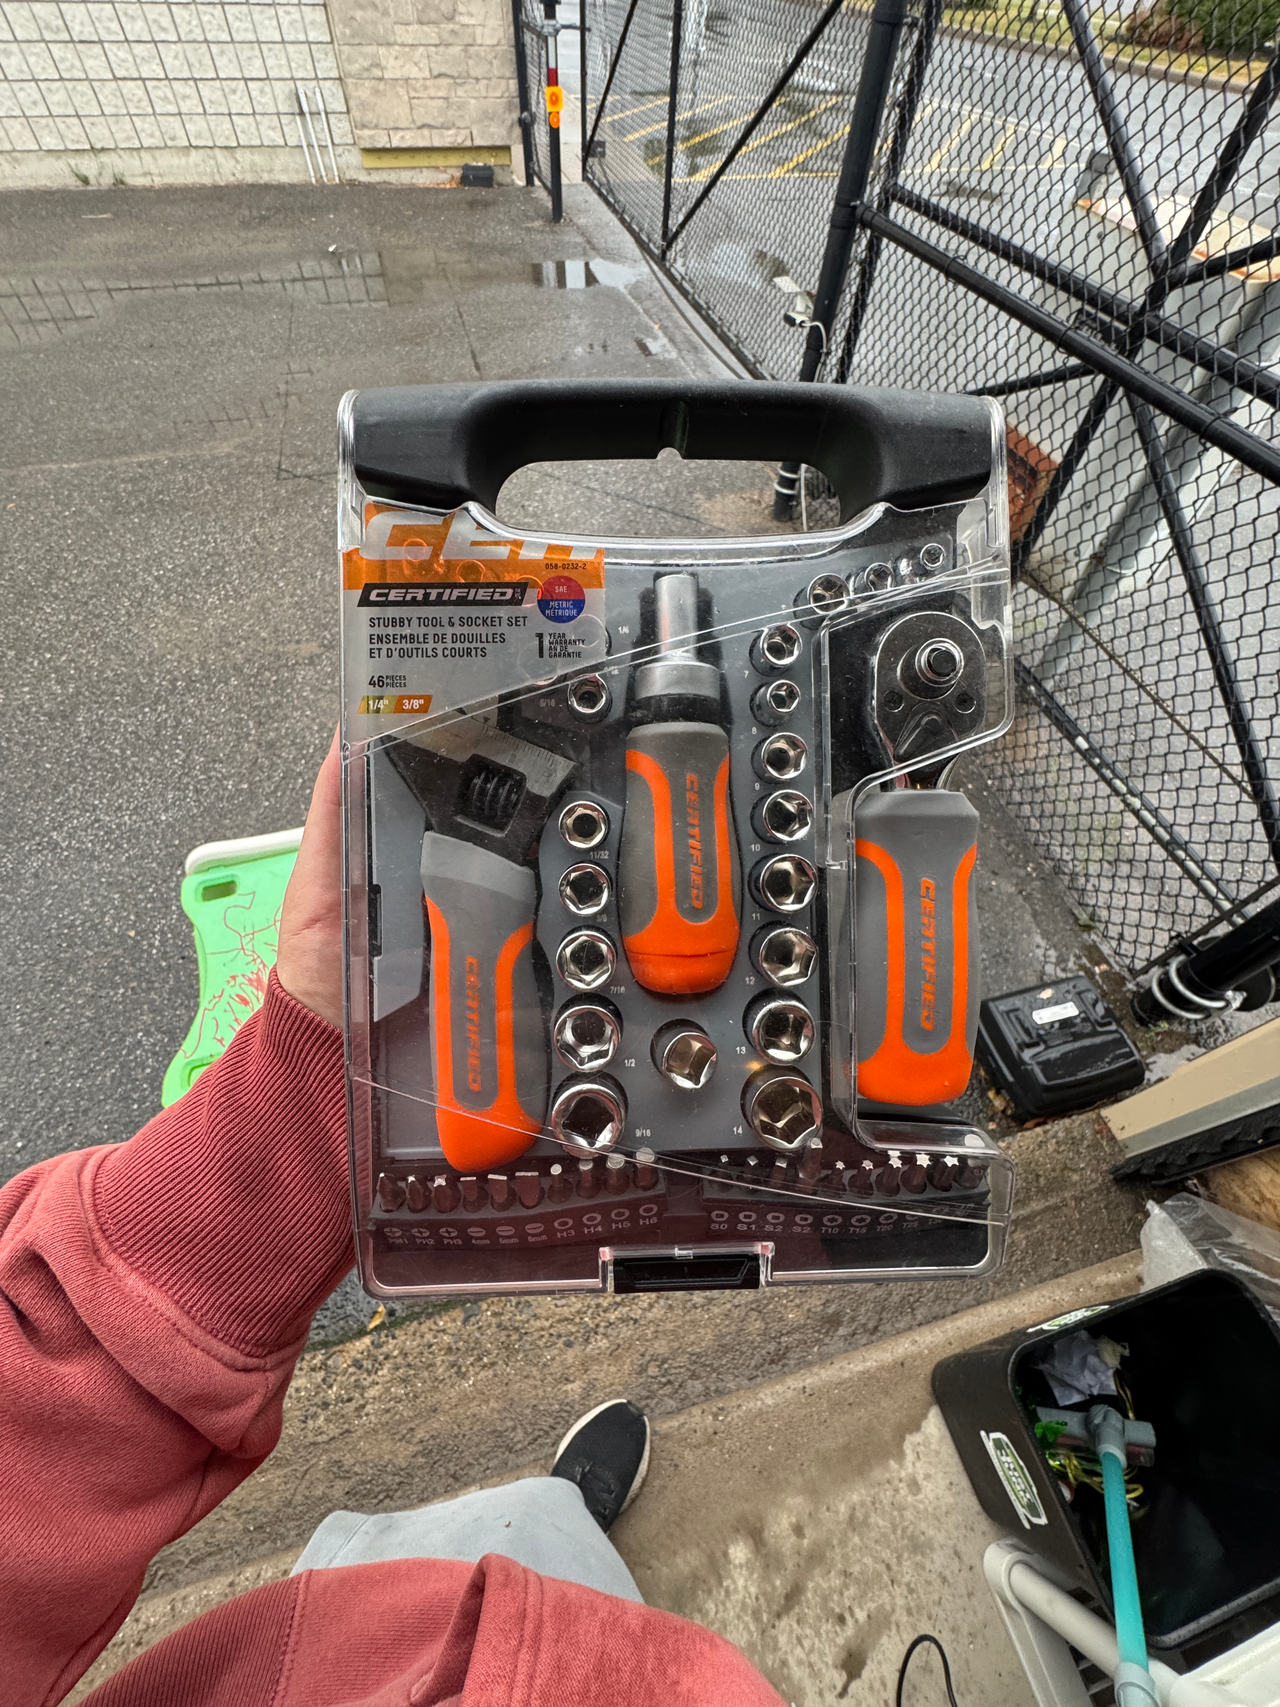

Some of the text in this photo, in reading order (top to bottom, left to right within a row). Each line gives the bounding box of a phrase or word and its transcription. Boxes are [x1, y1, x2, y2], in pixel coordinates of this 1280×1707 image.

[554, 585, 568, 593] SAE
[369, 588, 514, 601] CERTIFIED
[549, 600, 574, 609] METRIC
[369, 616, 528, 628] STUBBY TOOL & SOCKET SET
[369, 632, 506, 645] ENSEMBLE DE DOUILLES
[535, 633, 544, 659] 1
[369, 647, 488, 659] ET D'OUTILS COURTS
[548, 651, 582, 659] GARANTIE
[744, 670, 750, 679] 7
[368, 675, 385, 688] 46
[368, 699, 389, 710] 1/4"
[402, 699, 425, 710] 3/8"
[751, 727, 757, 735] 8
[754, 782, 760, 791] 9
[686, 773, 703, 909] CERTIFIED
[750, 843, 761, 852] 10
[590, 851, 609, 860] 11/32
[752, 912, 761, 921] 11
[920, 877, 936, 1031] CERTIFIED
[745, 976, 756, 985] 12
[610, 986, 626, 995] 7/16
[465, 955, 482, 1092] CERTIFIED
[735, 1045, 746, 1055] 13
[624, 1058, 636, 1068] 1/2
[635, 1128, 651, 1138] 9/16
[732, 1124, 743, 1136] 14
[556, 1228, 576, 1239] H3
[583, 1225, 603, 1235] H4
[736, 1222, 757, 1232] S1
[764, 1223, 784, 1232] S2
[821, 1226, 840, 1235] T10
[849, 1226, 868, 1235] T15
[876, 1224, 894, 1233] T20
